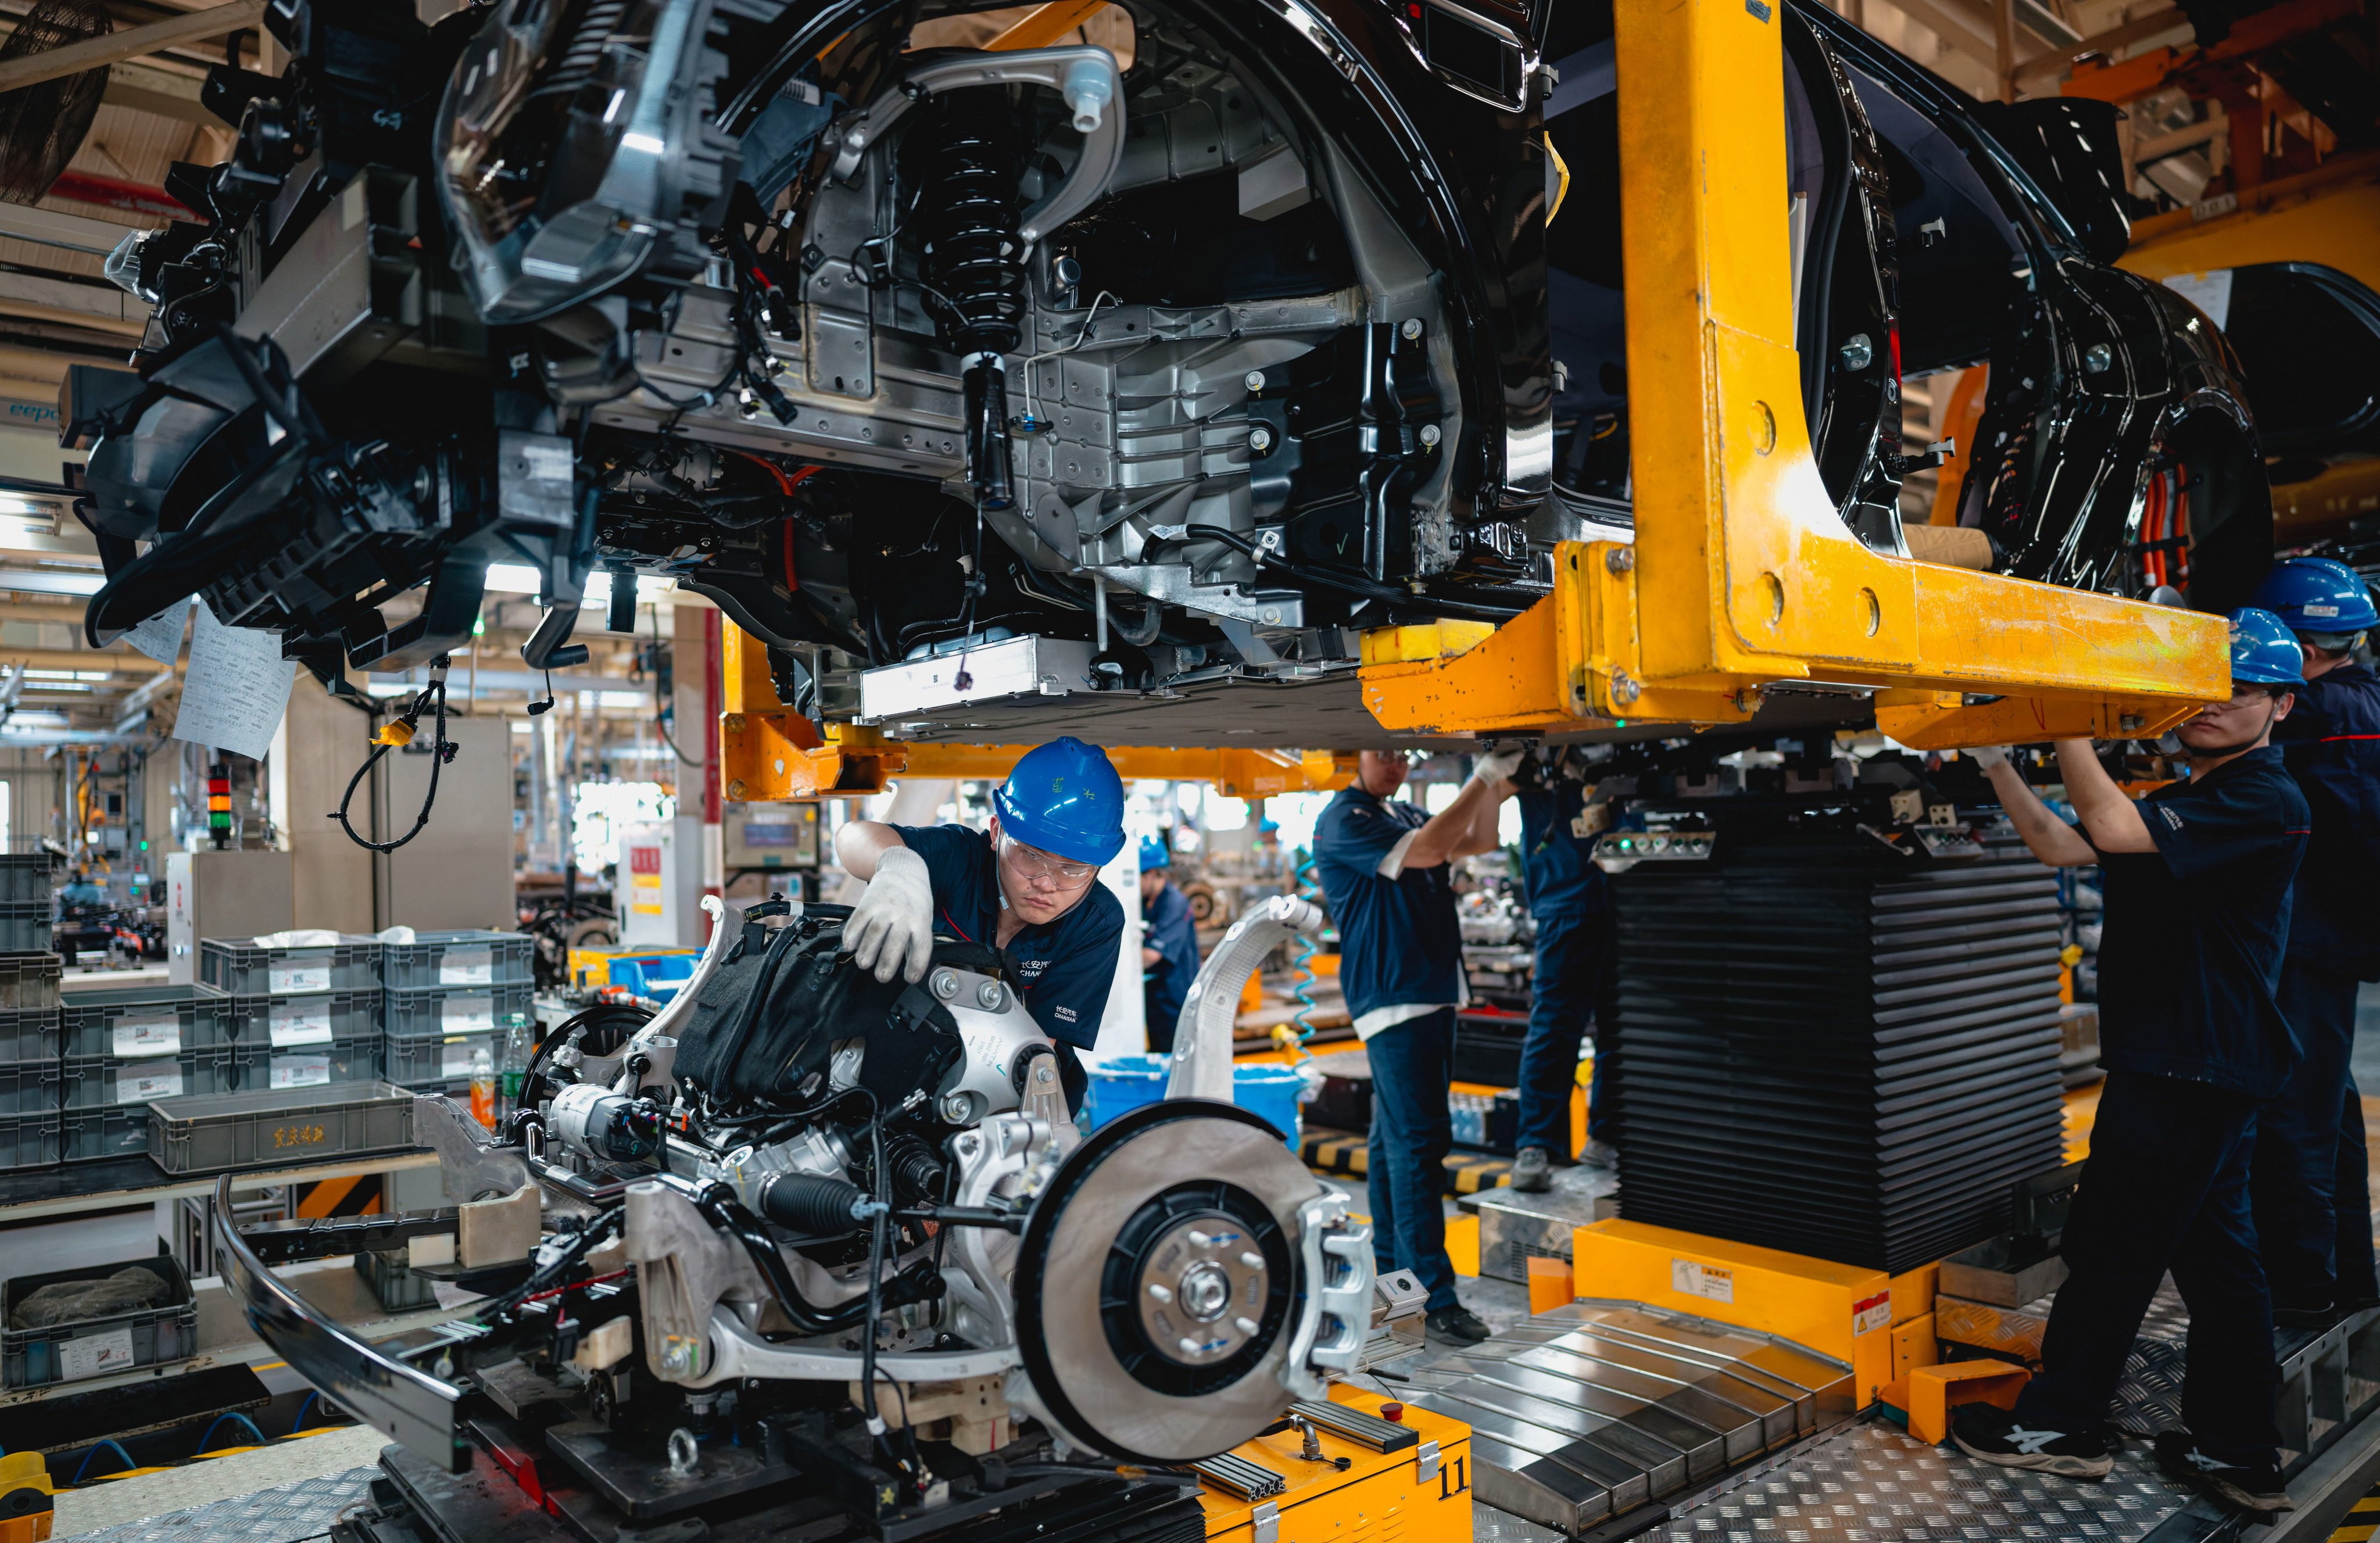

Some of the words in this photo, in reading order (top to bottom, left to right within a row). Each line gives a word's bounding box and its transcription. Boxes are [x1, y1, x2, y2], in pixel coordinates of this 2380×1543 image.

[1055, 1005, 1077, 1017] 长安汽车
[1054, 1012, 1076, 1023] CHANGAN
[1438, 1455, 1469, 1501] 11
